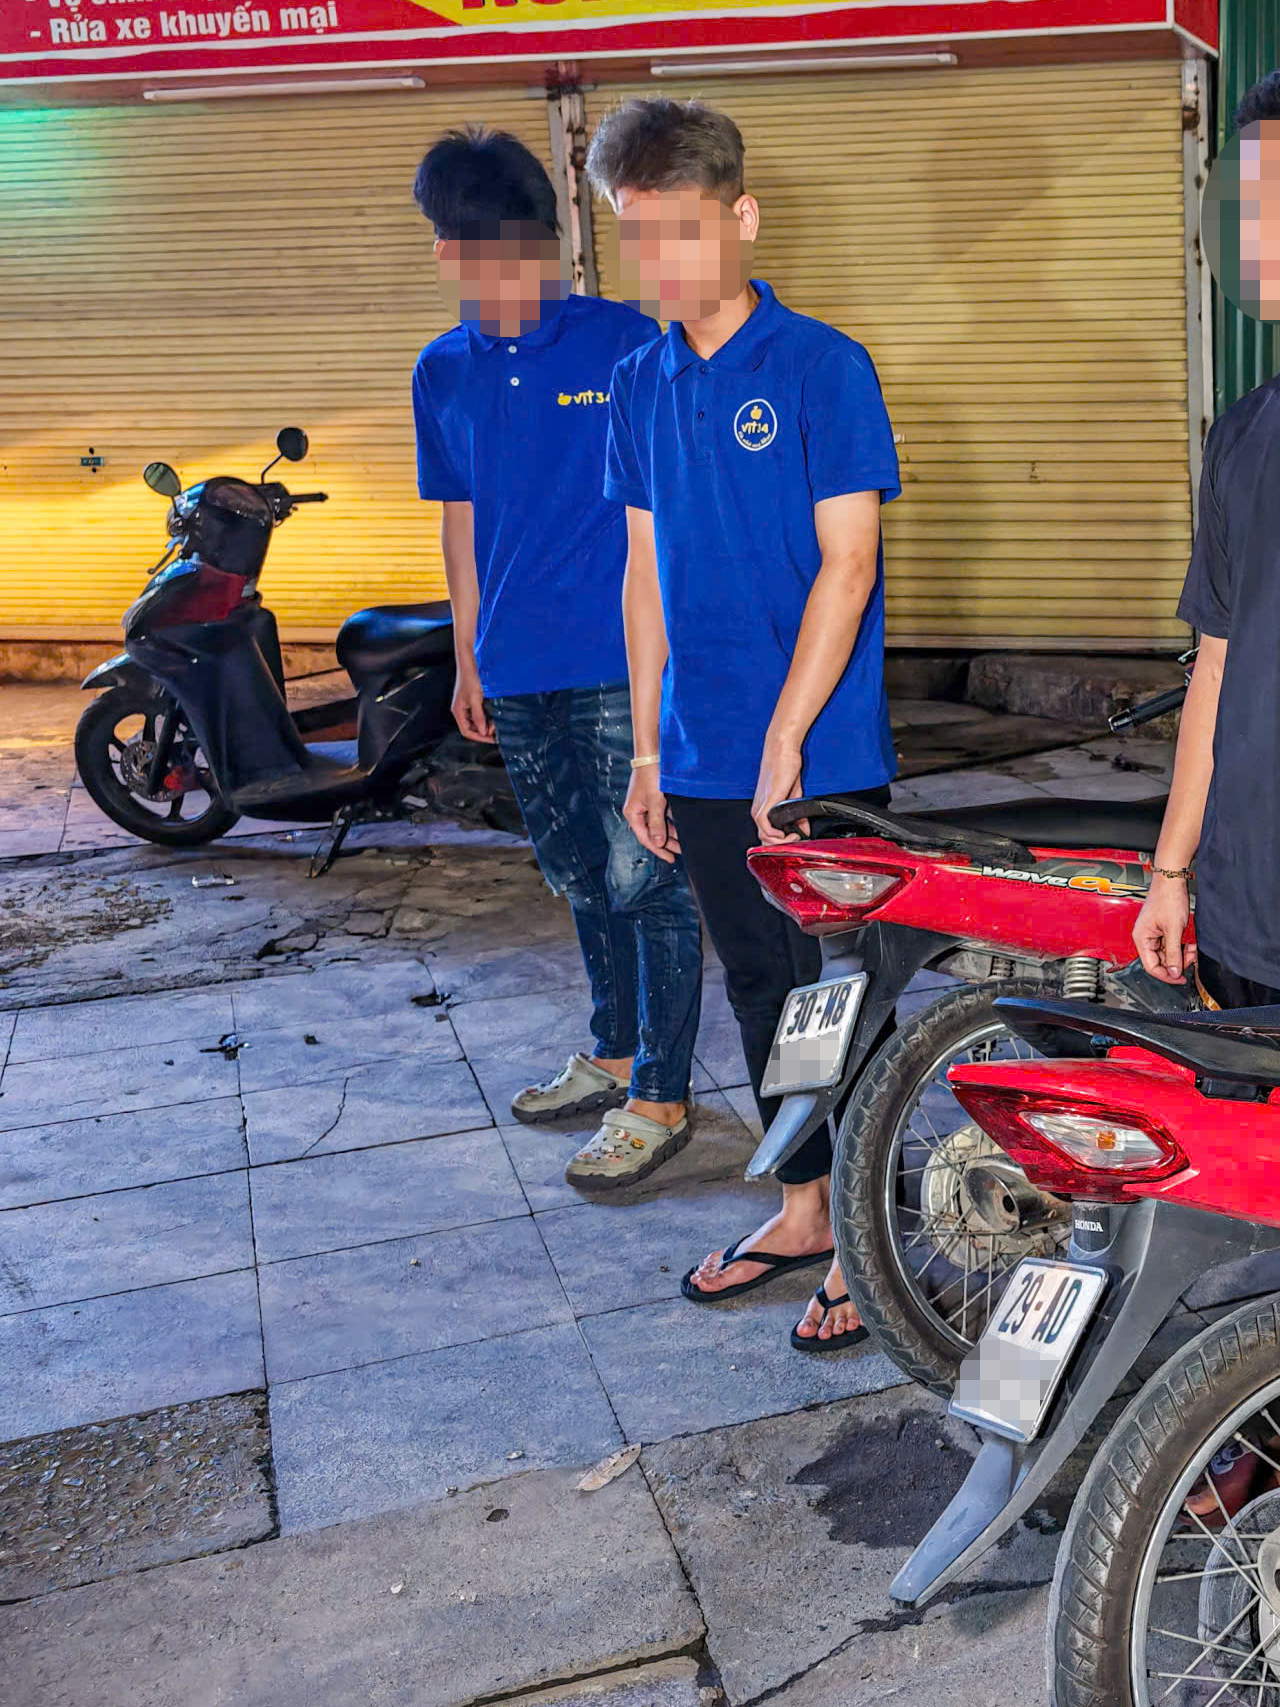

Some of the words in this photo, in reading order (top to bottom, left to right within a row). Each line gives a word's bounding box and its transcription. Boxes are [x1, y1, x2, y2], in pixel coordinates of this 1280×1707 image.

[50, 14, 107, 44] Rửa
[115, 16, 151, 40] xe
[159, 1, 271, 38] khuyến
[280, 1, 339, 34] mại
[1074, 1219, 1104, 1233] HONDA
[997, 1271, 1083, 1345] 29-AD
